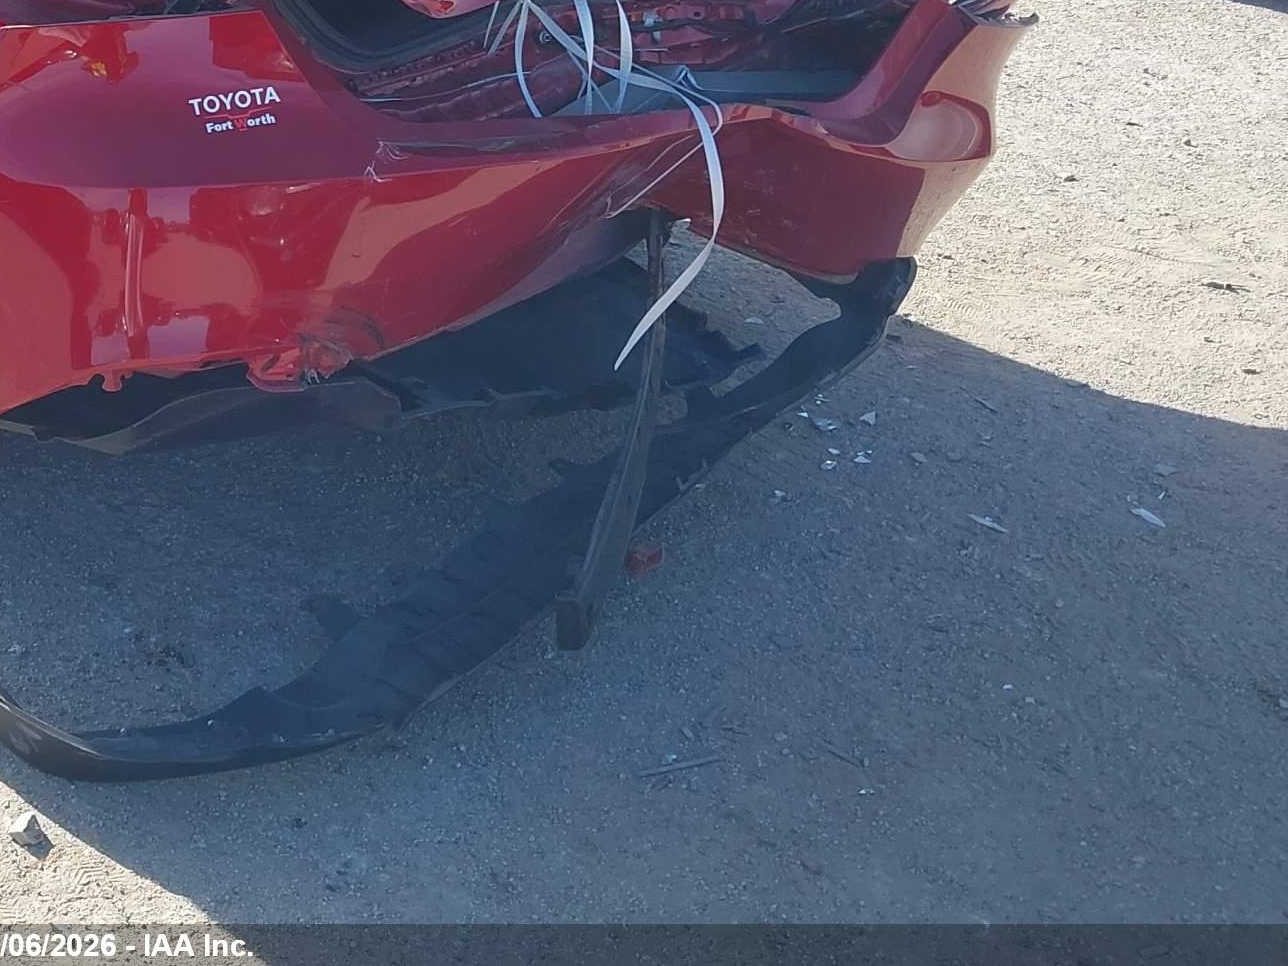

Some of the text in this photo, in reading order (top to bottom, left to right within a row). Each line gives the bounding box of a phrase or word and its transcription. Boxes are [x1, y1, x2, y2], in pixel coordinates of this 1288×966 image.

[188, 86, 281, 116] TOYOTA
[205, 113, 277, 134] Fort Worth
